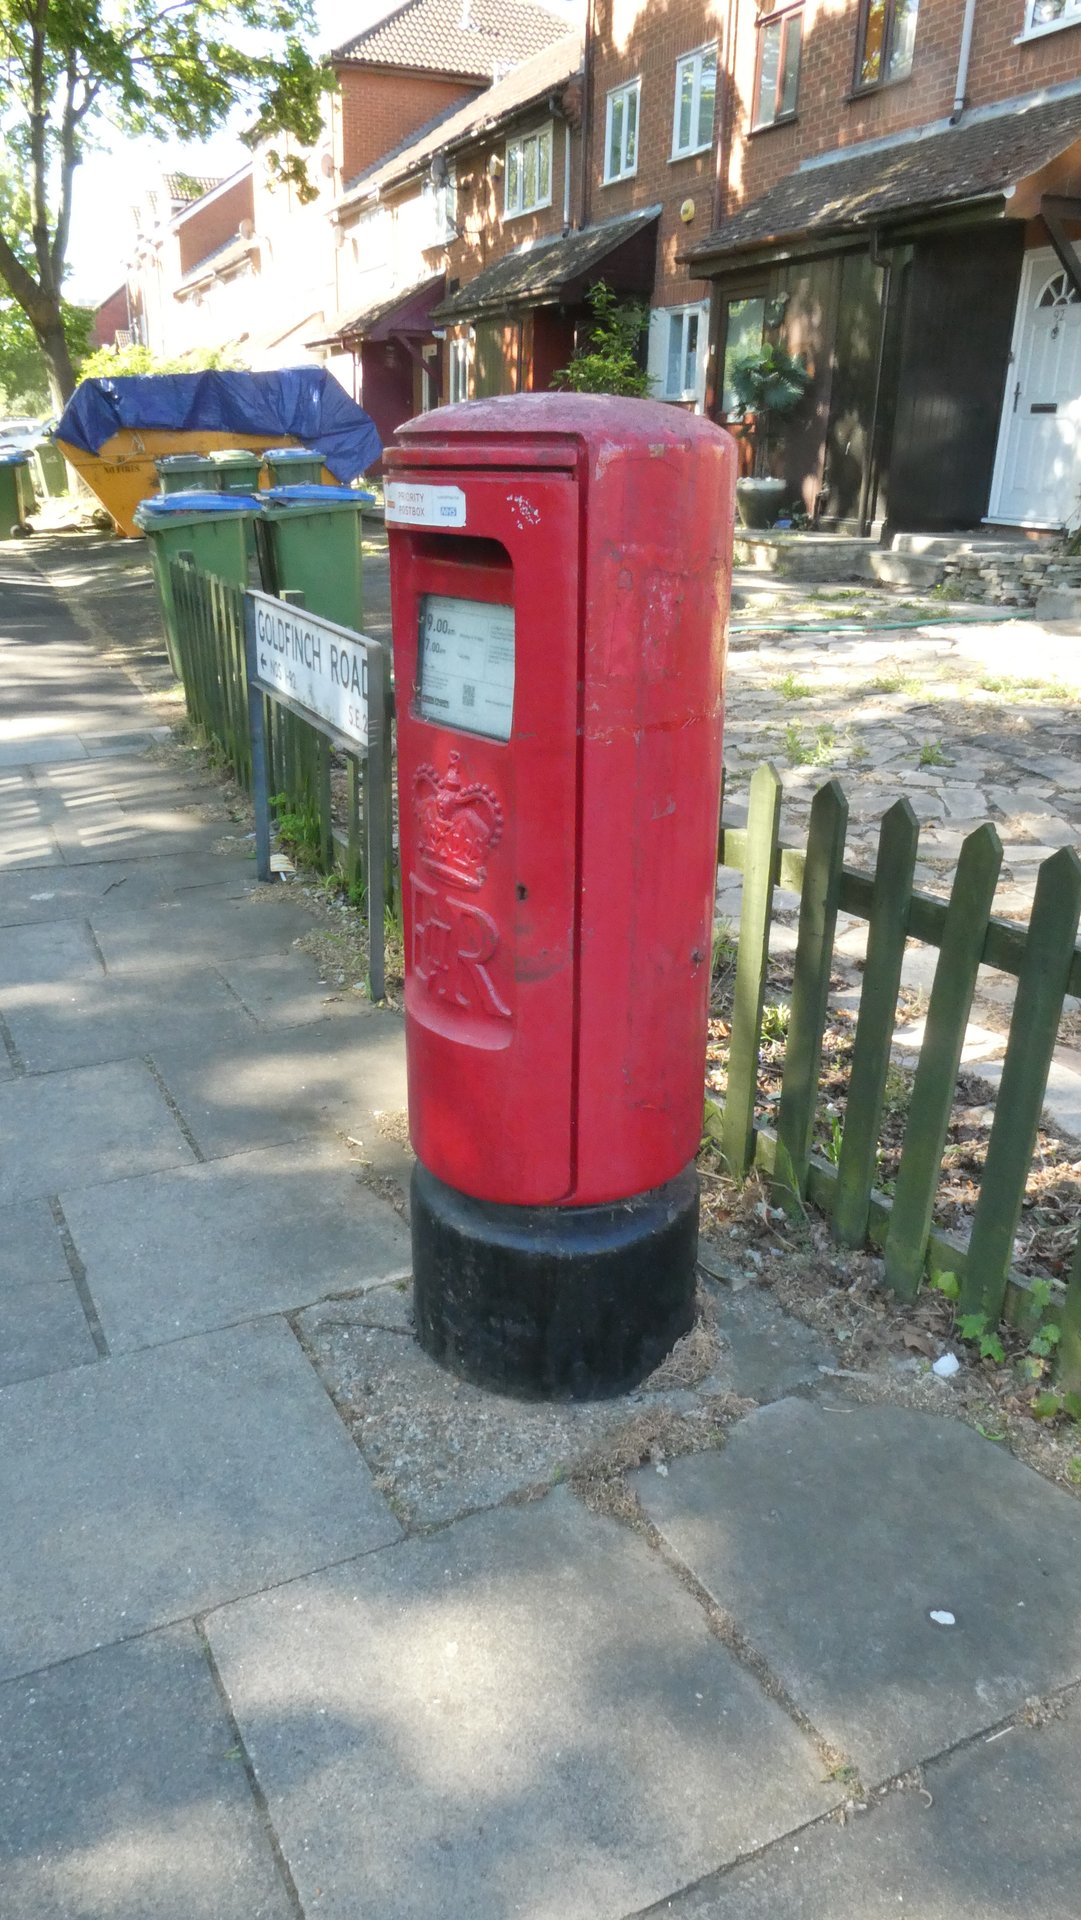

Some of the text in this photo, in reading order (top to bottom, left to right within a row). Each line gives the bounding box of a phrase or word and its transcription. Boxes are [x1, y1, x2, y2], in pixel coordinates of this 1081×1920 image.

[398, 505, 425, 517] POSTBOX
[440, 506, 457, 517] NHS
[257, 609, 368, 701] GOLDFINCH ROAD
